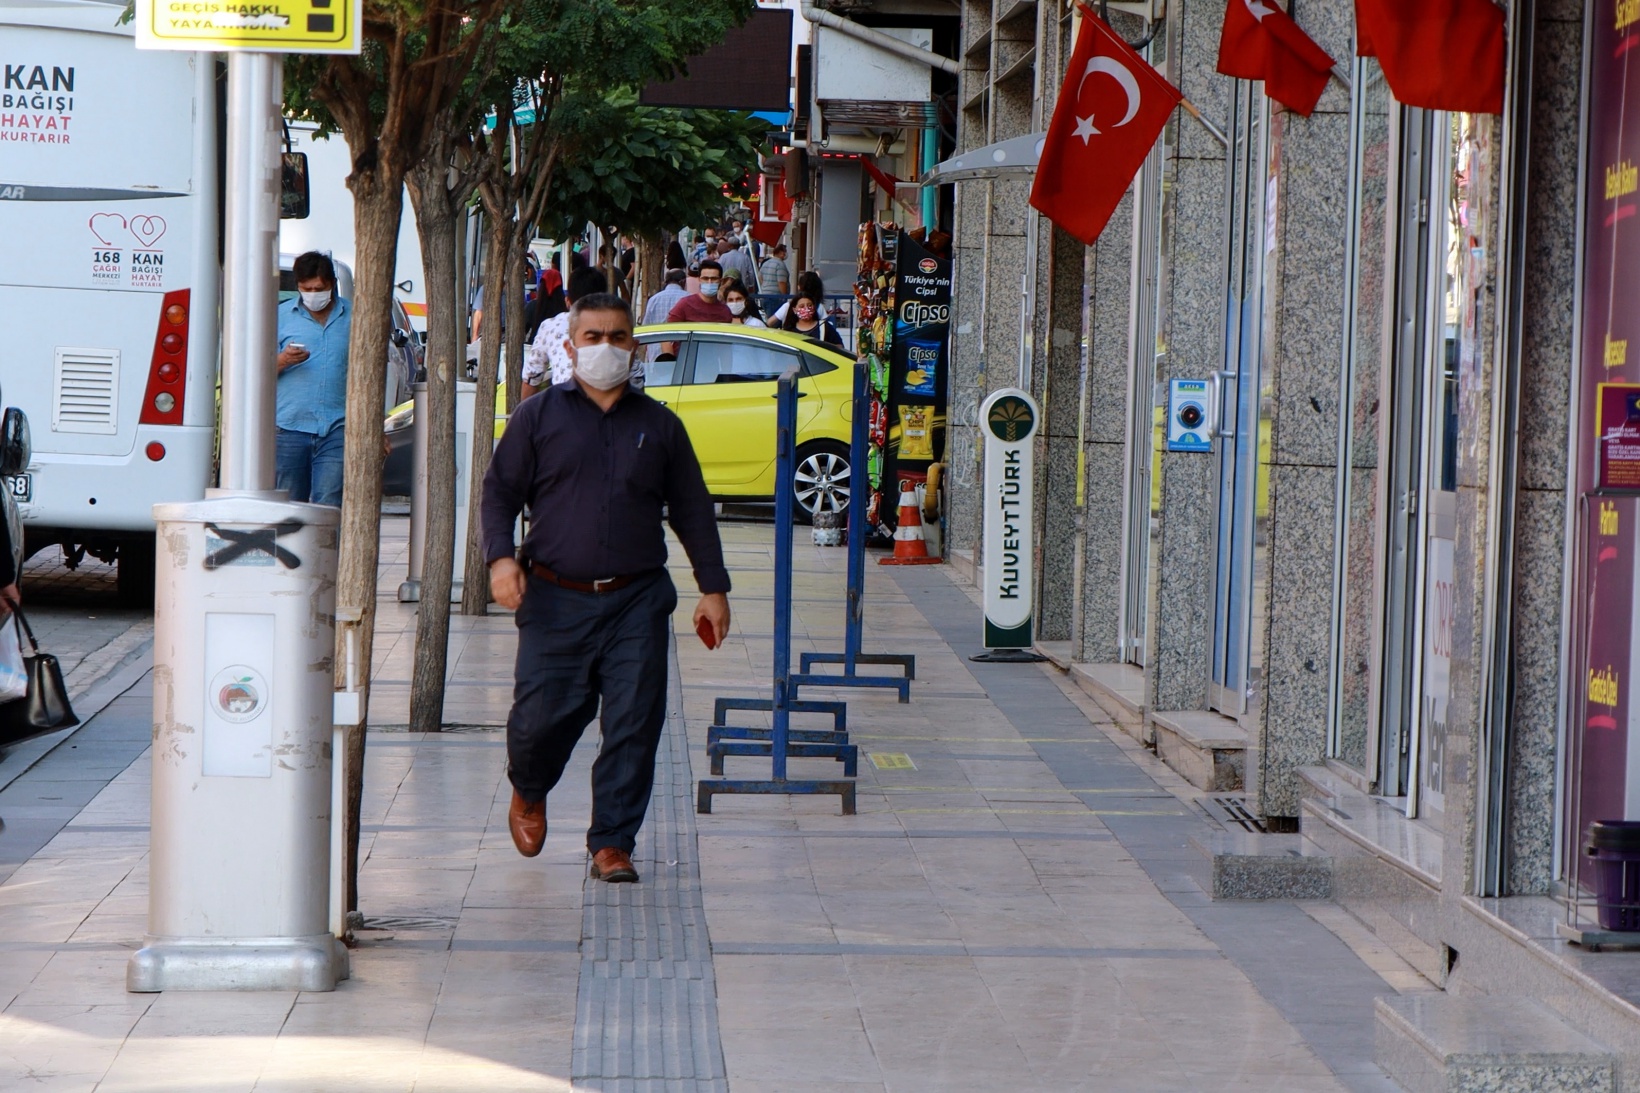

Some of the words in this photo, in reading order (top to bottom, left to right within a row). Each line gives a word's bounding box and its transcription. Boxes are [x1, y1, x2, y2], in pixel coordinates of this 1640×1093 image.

[225, 4, 280, 15] HAKKI
[4, 64, 75, 92] KAN
[2, 92, 73, 115] BAĞIŞI
[1, 113, 72, 131] HAYAT
[0, 131, 71, 145] KURTARIR
[93, 251, 121, 264] 168
[132, 253, 163, 266] KAN
[93, 264, 121, 273] ÇAĞRI
[132, 265, 163, 275] BAĞIŞI
[132, 274, 163, 282] HAYAT
[904, 275, 950, 287] Türkiye'nin
[900, 300, 950, 329] Cipso
[909, 346, 939, 364] Cipso
